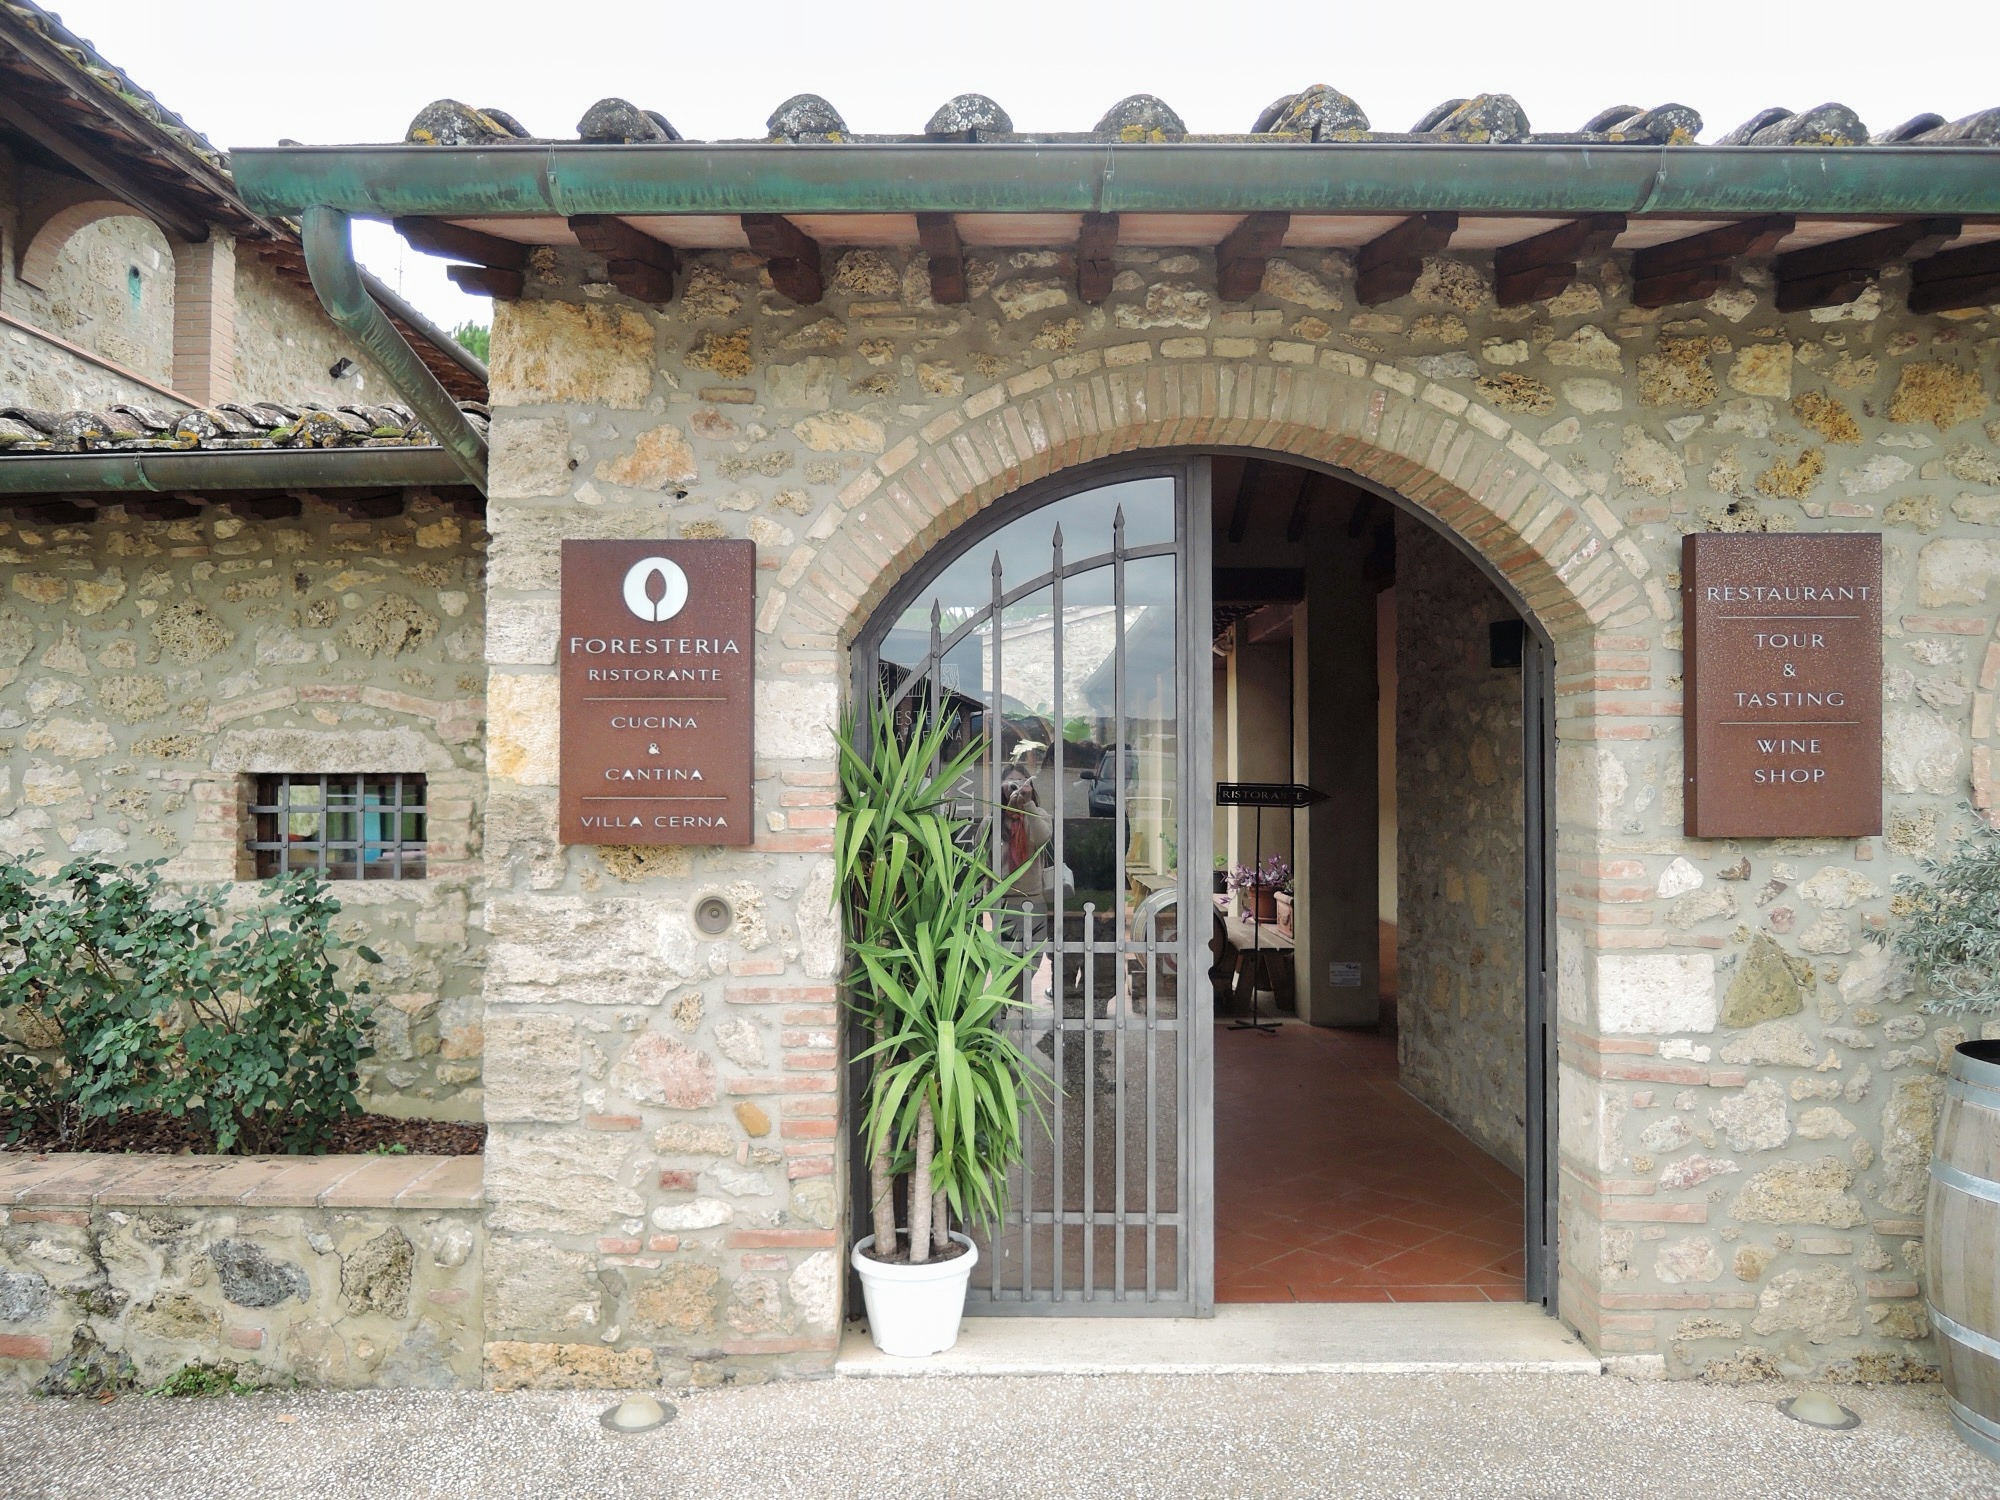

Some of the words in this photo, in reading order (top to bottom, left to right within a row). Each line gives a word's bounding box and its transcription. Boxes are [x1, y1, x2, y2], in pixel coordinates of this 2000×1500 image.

[1706, 586, 1871, 602] RESTAURANT
[569, 637, 740, 655] FORESTERIA
[1753, 633, 1826, 649] TOUR
[588, 668, 723, 682] RISTORANTE
[1783, 663, 1796, 677] &
[1733, 691, 1845, 707] TASTING
[610, 715, 699, 729] CUCINA
[648, 743, 661, 755] &
[1756, 738, 1822, 754] WINE
[604, 767, 704, 782] CANTINA
[1753, 768, 1826, 784] SHOP
[1222, 789, 1304, 801] RISTORANE
[580, 815, 644, 829] VILLA
[654, 815, 729, 829] CERNA
